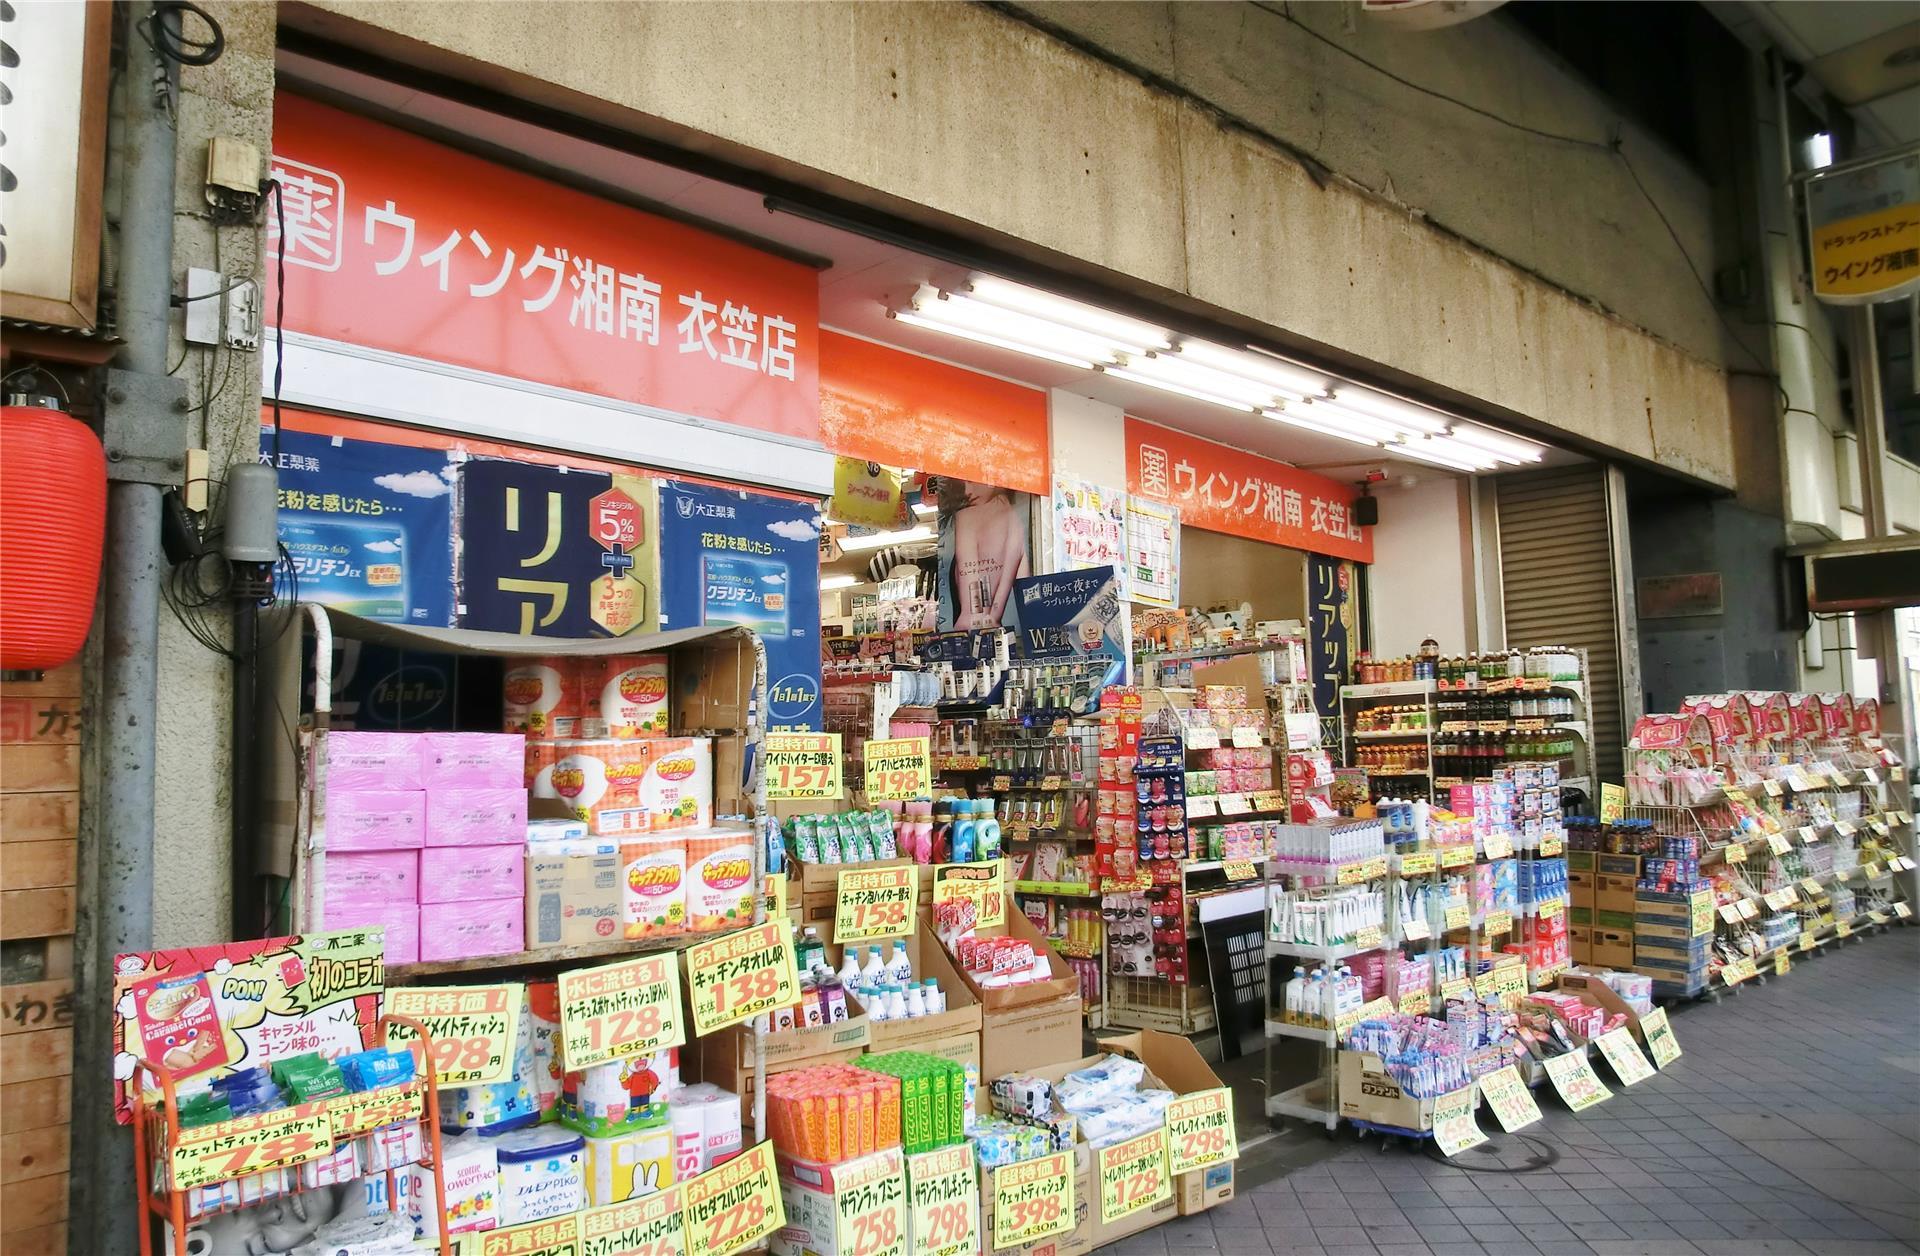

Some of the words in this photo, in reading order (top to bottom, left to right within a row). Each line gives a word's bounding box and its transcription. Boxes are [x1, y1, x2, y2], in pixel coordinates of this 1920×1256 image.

[677, 290, 796, 382] 衣笠店
[696, 504, 736, 519] 大正製薬
[707, 586, 755, 602] クラリチン
[629, 864, 681, 886] キッチンタオル
[703, 859, 750, 882] キッチンタオル
[942, 881, 998, 896] カビキラー
[328, 934, 365, 950] 不二家
[222, 978, 267, 1002] PON!
[259, 1019, 316, 1041] キャラメル
[373, 1058, 399, 1073] 除菌
[435, 1070, 482, 1082] 14円
[1363, 1084, 1399, 1097] タフデント
[175, 1116, 327, 1160] ウェットティッシュポケット
[840, 1177, 901, 1218] サランラップミニ
